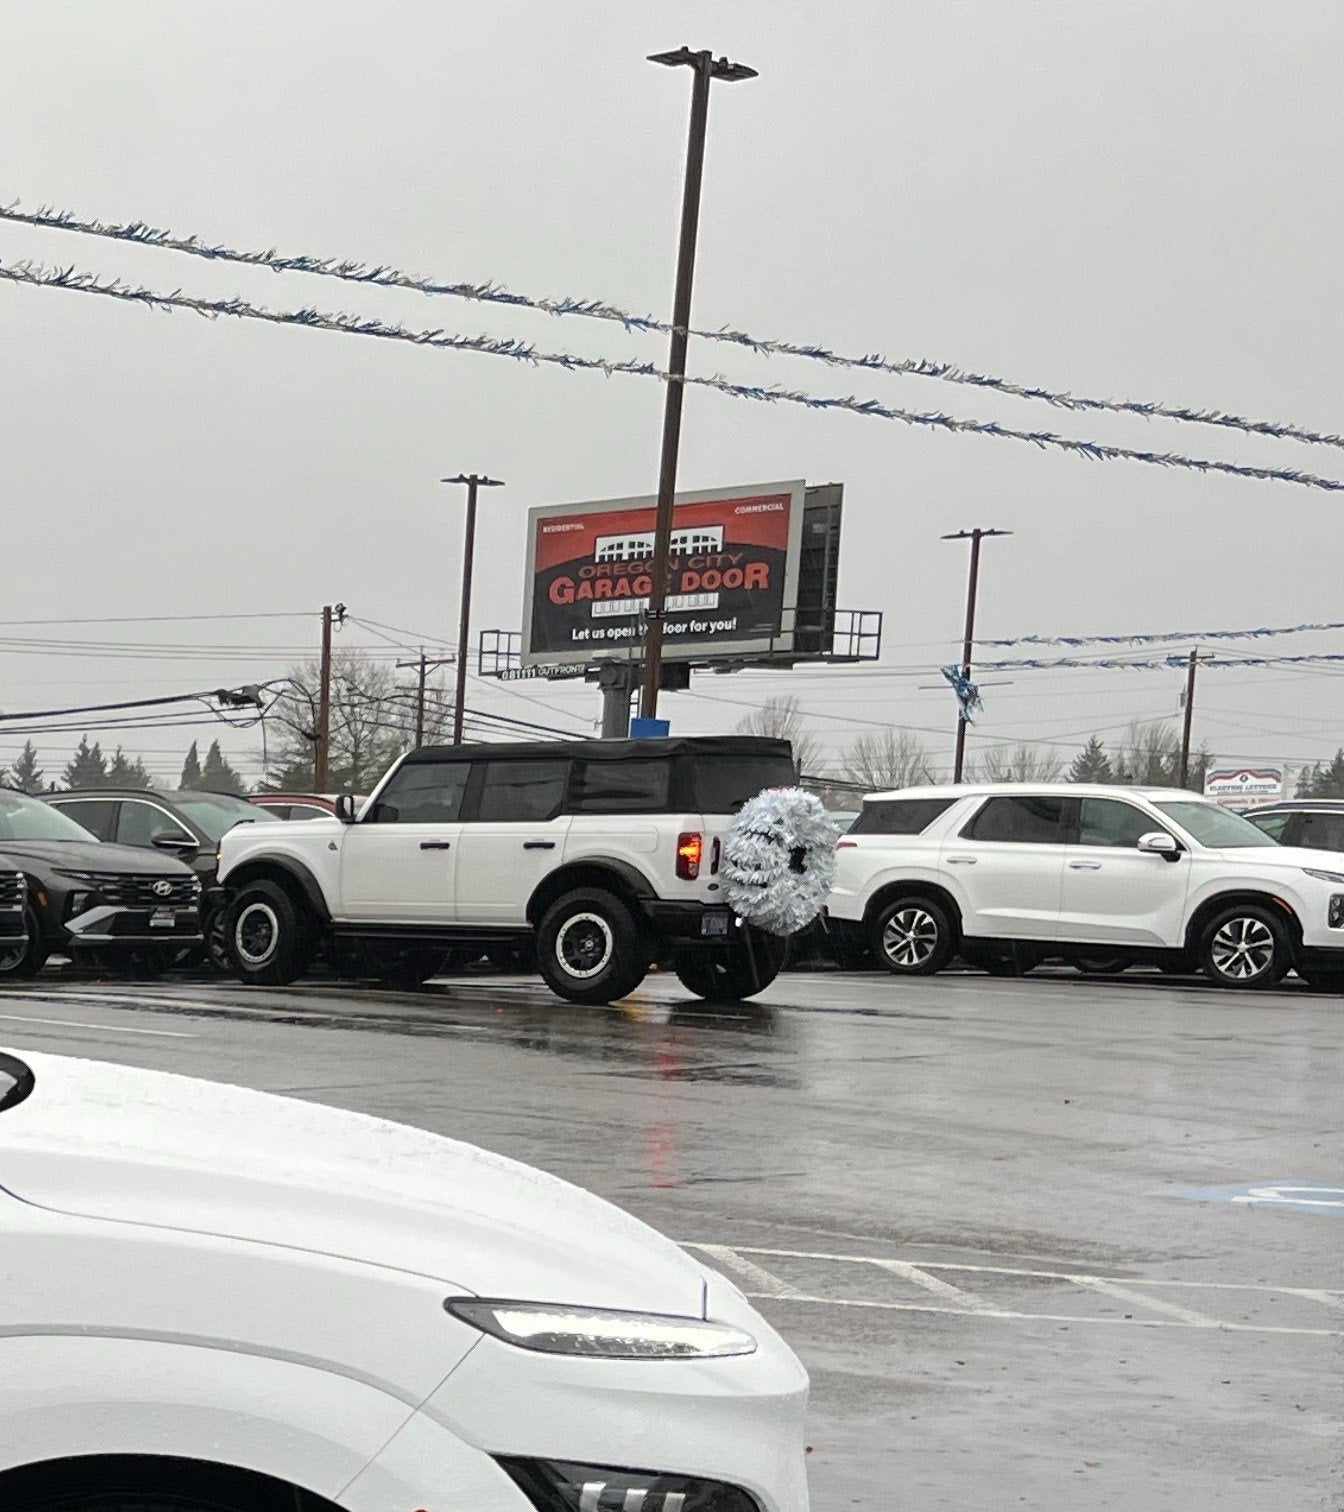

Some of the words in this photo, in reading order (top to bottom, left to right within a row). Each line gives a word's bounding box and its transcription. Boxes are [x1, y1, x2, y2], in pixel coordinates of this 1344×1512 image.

[734, 503, 784, 514] COMMERCIAL
[688, 551, 744, 569] CITY
[680, 563, 770, 592] DOOR
[571, 628, 590, 640] Let
[592, 629, 606, 639] us
[607, 627, 636, 640] open
[689, 619, 709, 633] for
[709, 616, 737, 634] you!
